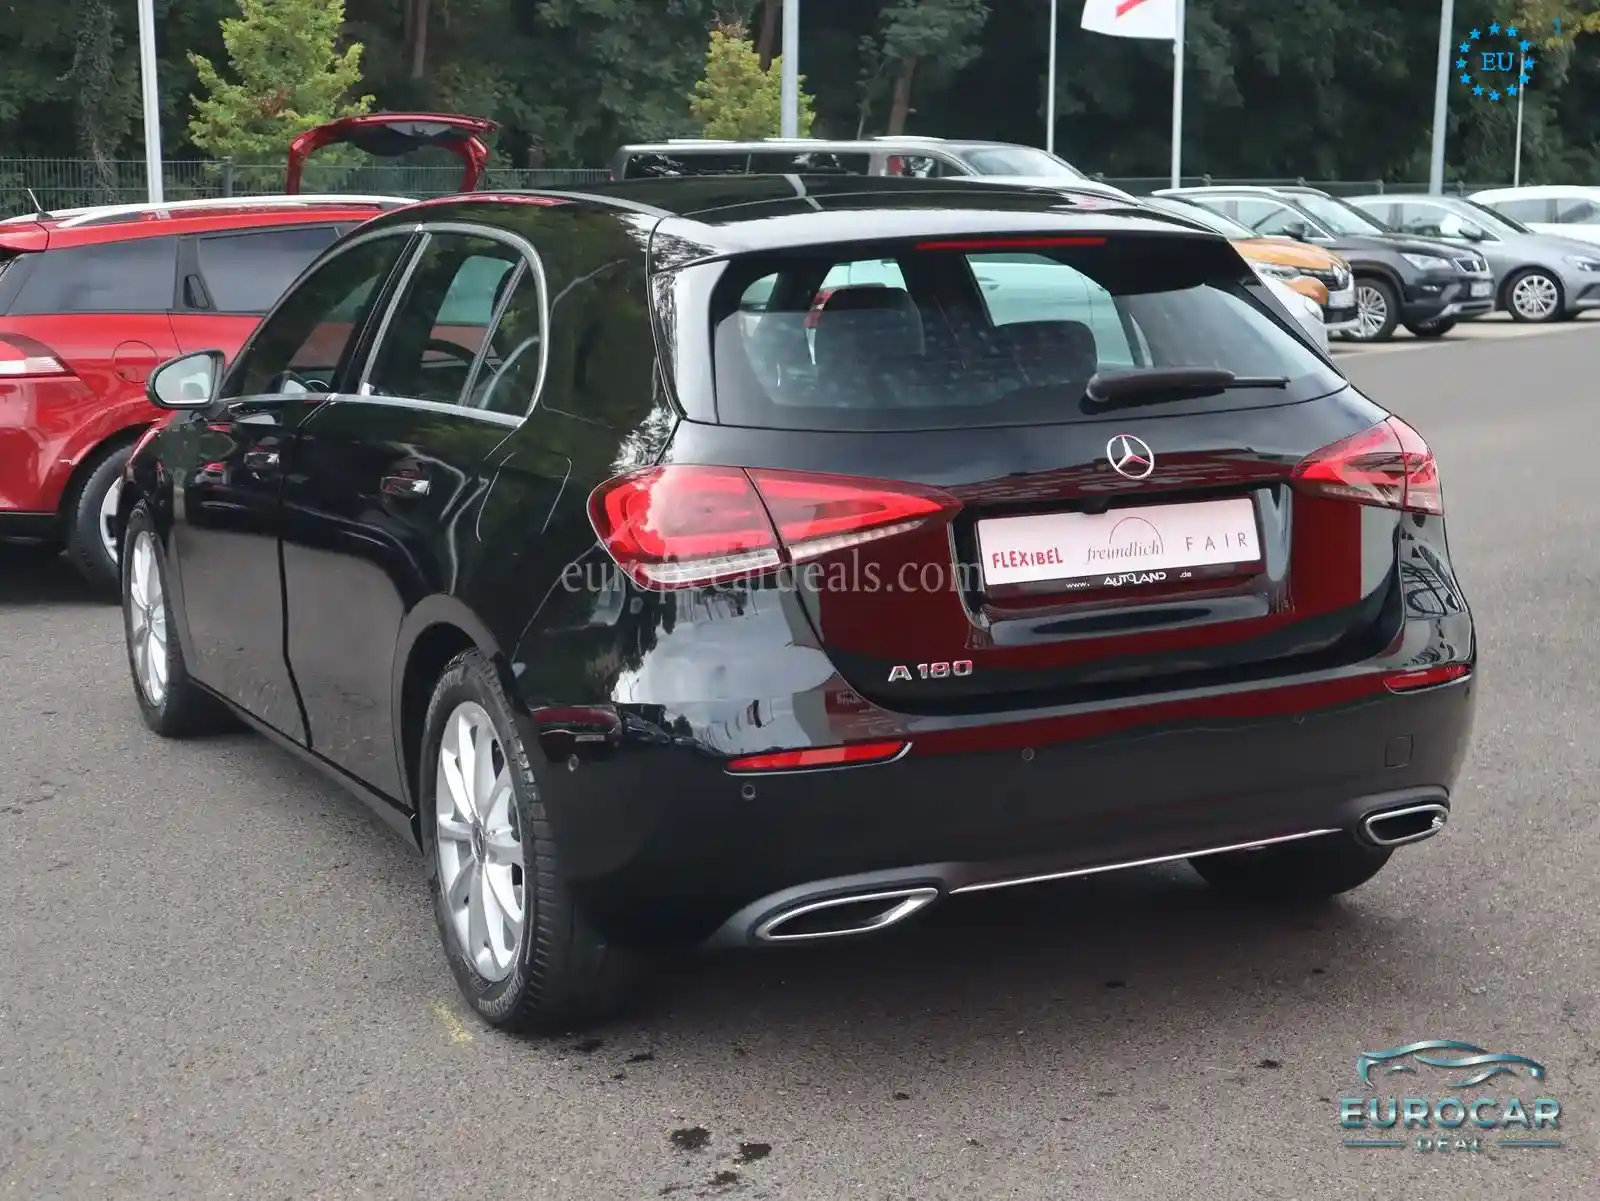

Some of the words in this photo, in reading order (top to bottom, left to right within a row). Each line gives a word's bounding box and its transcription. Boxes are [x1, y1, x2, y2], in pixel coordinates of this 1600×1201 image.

[992, 547, 1063, 569] FLEXIBEL
[1085, 540, 1161, 564] freundlich
[1185, 532, 1247, 552] FAIR
[1104, 571, 1167, 587] AUTOLAND
[888, 665, 912, 682] A
[917, 660, 973, 680] 180
